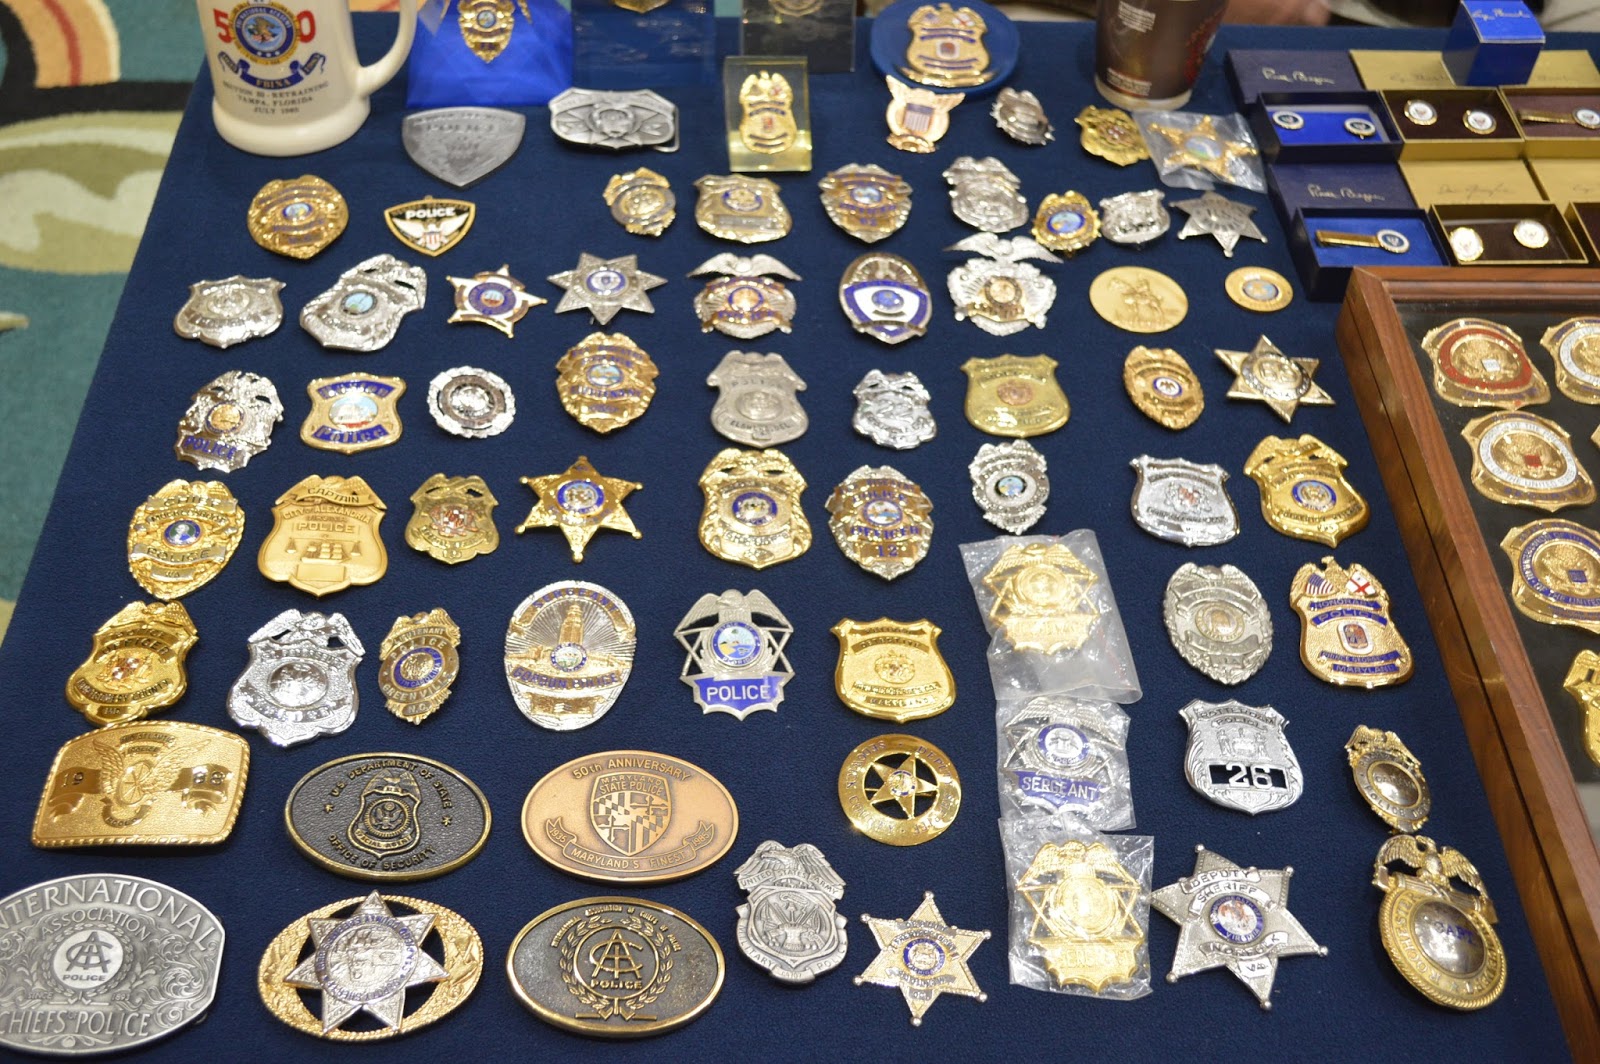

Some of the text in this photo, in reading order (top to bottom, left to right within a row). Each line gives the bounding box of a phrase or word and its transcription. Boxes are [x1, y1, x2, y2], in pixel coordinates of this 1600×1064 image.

[254, 106, 276, 114] JULY
[273, 96, 313, 106] FLORIDA
[405, 207, 456, 220] POLICE
[317, 426, 386, 443] Police
[183, 435, 240, 461] POLICE
[163, 495, 222, 508] CHIEF
[307, 487, 360, 504] CAPTAIN
[282, 508, 304, 520] CITY
[314, 505, 372, 524] ALEXANDRIA
[298, 521, 356, 534] POLICE
[146, 547, 210, 562] POLICE
[878, 544, 898, 557] 12
[532, 587, 619, 611] SERGEANT
[1314, 597, 1376, 609] HONORARY
[1318, 609, 1381, 621] POLICE
[393, 626, 446, 645] LIEUTENANT
[390, 636, 448, 660] POLICE
[1336, 664, 1397, 673] MARYLAND
[382, 671, 455, 702] GREENVILLE
[706, 685, 772, 701] POLICE
[62, 770, 226, 788] 19 88
[572, 758, 691, 782] 50th ANNIVERSARY
[1226, 763, 1273, 789] 26
[349, 759, 418, 779] DEPARTMENT
[418, 768, 434, 780] OF
[432, 779, 453, 809] STATE
[599, 781, 664, 796] STATE POLICE
[601, 774, 662, 786] MARYLAND
[1021, 776, 1099, 800] SERGEANT
[1364, 784, 1407, 817] POLICE
[549, 827, 711, 847] 1935 1985
[327, 833, 437, 871] OFFICE OF SECURITY
[649, 850, 686, 868] FINEST
[740, 869, 840, 895] UNITED STATES ARMY
[1191, 869, 1252, 889] DEPUTY
[1197, 881, 1258, 904] SHERIFF
[0, 878, 216, 952] NTERNATIONAL
[40, 907, 152, 942] ASSOCIATION
[584, 905, 623, 917] ASSOCIATION
[627, 906, 636, 914] OF
[639, 910, 659, 926] CHIEFS
[667, 933, 683, 952] POLICE
[1394, 891, 1442, 983] ROCHESTER
[738, 923, 777, 970] MILITARY
[62, 974, 107, 982] POLICE
[589, 979, 643, 990] POLICE
[27, 992, 131, 1002] SINCE 1893
[0, 1010, 67, 1034] CHIEFS
[75, 1010, 151, 1037] POLICE
